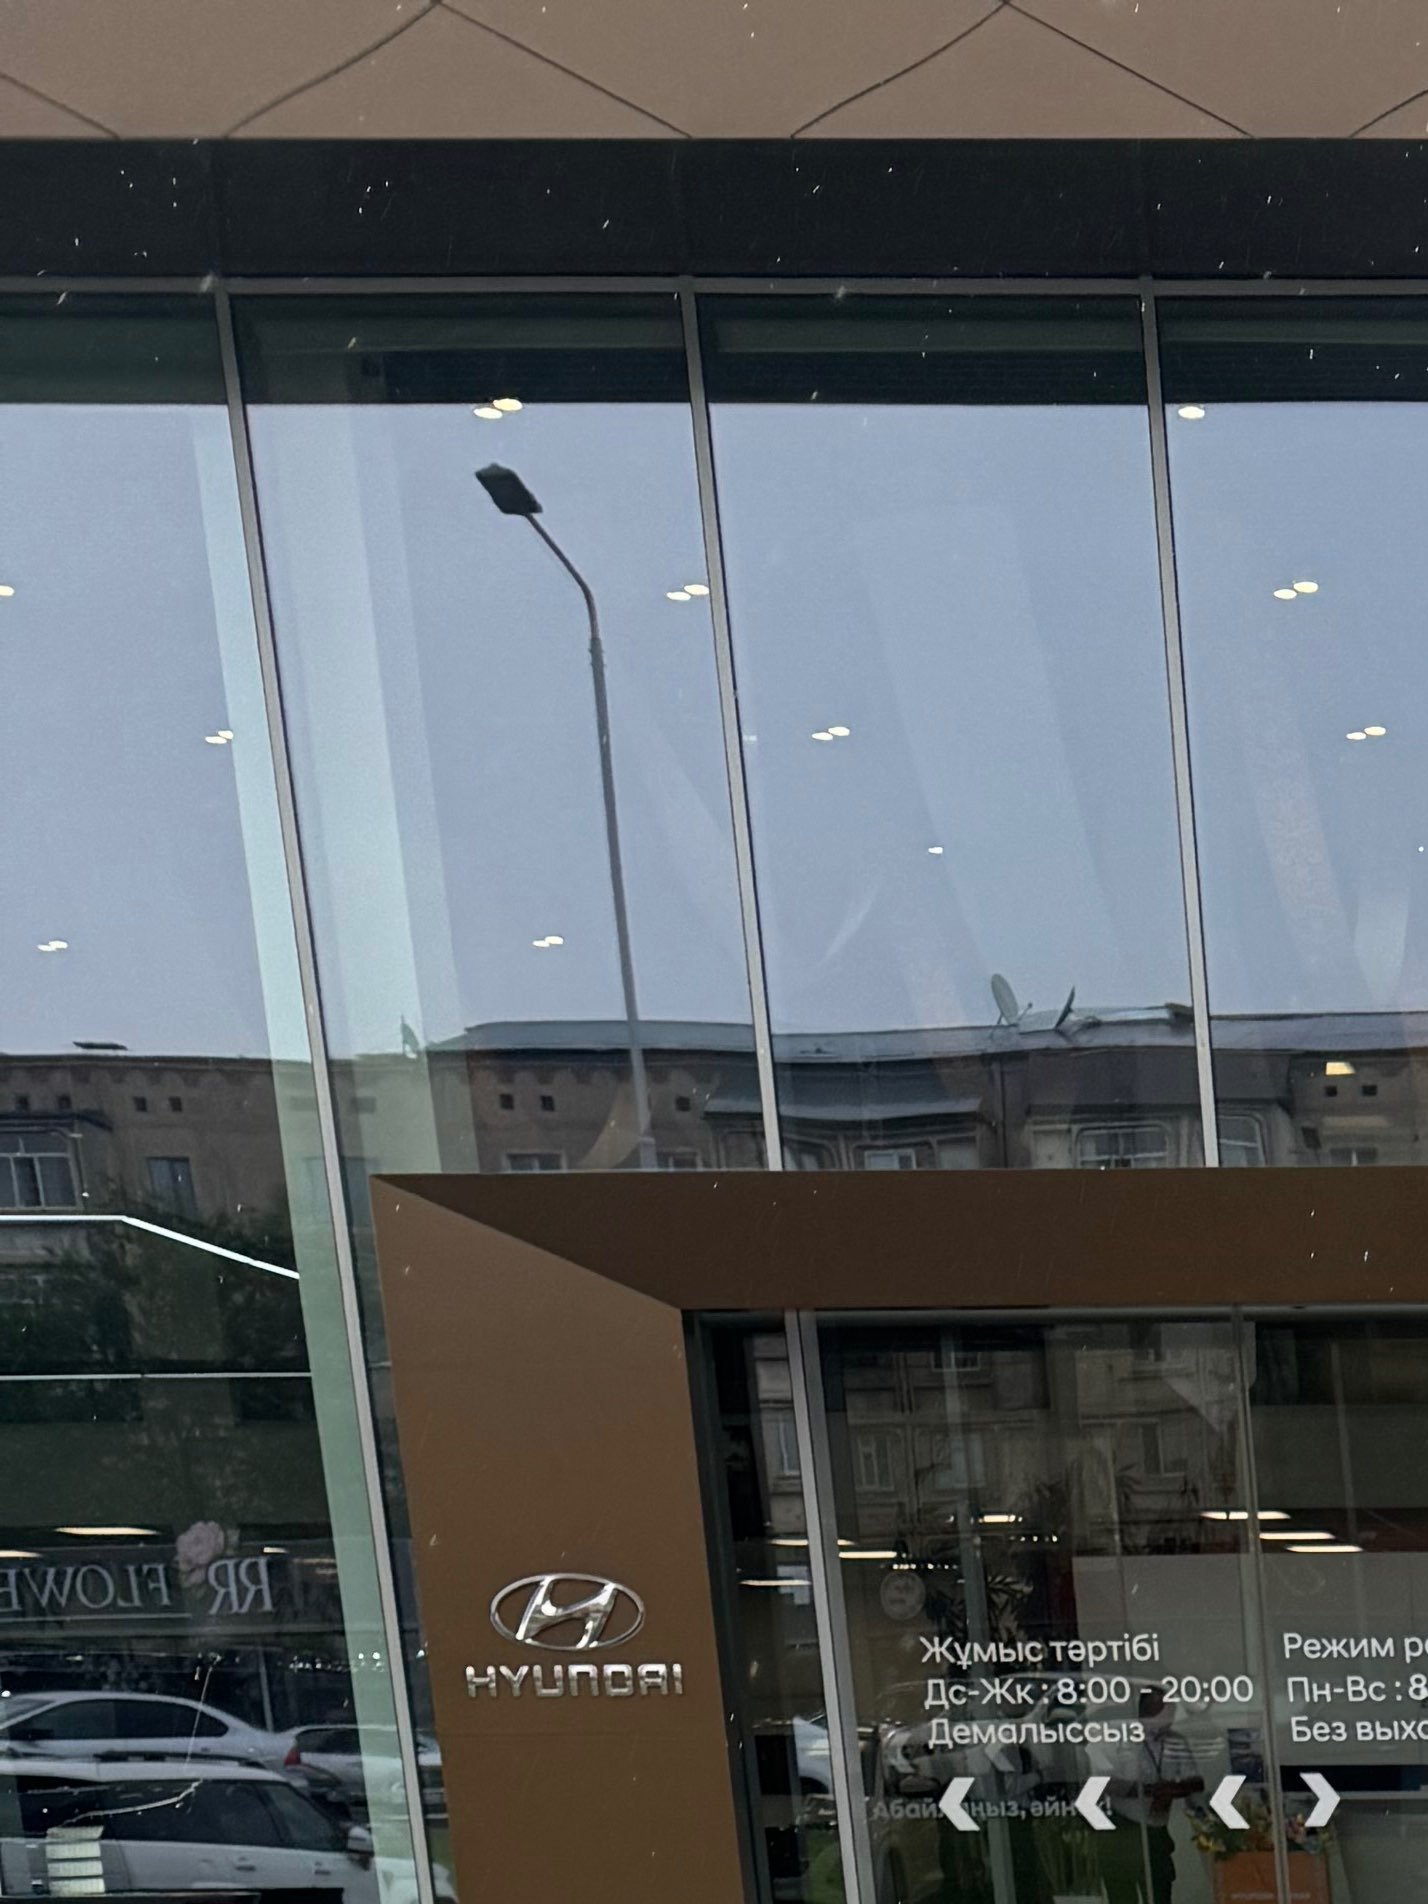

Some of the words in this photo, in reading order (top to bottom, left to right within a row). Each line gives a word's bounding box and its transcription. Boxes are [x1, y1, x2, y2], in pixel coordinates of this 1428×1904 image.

[919, 1636, 1044, 1670] Жұмыс
[1048, 1633, 1160, 1668] тәртібі
[1283, 1632, 1395, 1659] Режим
[465, 1663, 683, 1698] HYUNDAI
[1056, 1677, 1131, 1705] 8:00
[1161, 1675, 1254, 1703] 20:00
[1287, 1675, 1387, 1702] Пн-Вс
[928, 1718, 1146, 1750] Демалыссыз
[1291, 1715, 1348, 1742] Без
